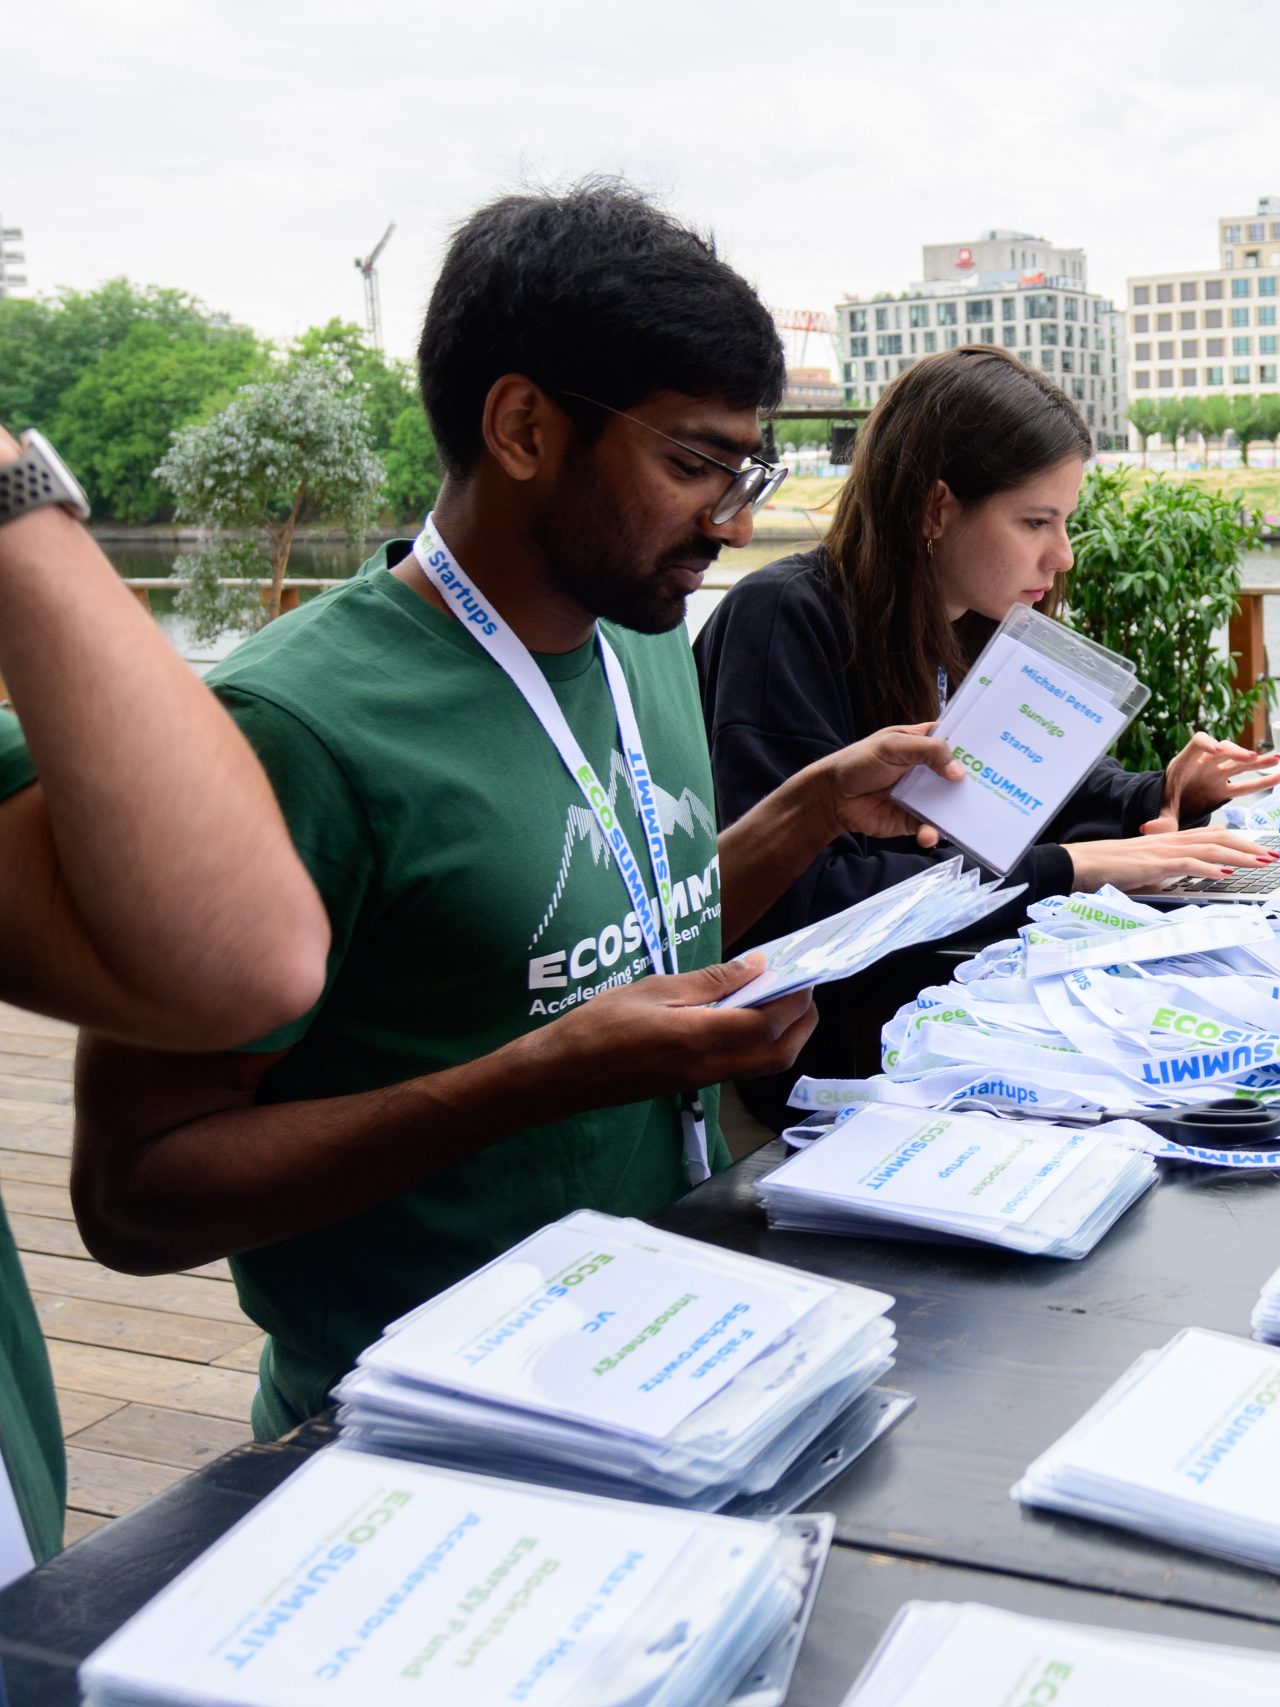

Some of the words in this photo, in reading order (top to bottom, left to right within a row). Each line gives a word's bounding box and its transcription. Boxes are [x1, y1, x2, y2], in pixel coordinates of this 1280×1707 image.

[428, 550, 498, 636] Startups
[1018, 703, 1066, 739] Sunvigo
[1020, 664, 1067, 700] Michael
[1065, 693, 1104, 725] Peters
[952, 746, 1044, 812] ECOSUMMIT
[999, 730, 1044, 765] Startup
[575, 764, 660, 952] ECOSUMMIT
[529, 965, 633, 1016] Accelerating
[865, 1120, 952, 1190] ECOSUMMIT
[937, 1144, 982, 1179] Startup
[463, 1253, 615, 1367] ECOSUMMIT
[582, 1310, 616, 1334] VC
[591, 1293, 699, 1377] InnoEnergy
[638, 1302, 751, 1393] Sacharowitz
[690, 1327, 755, 1378] Fabian
[224, 1489, 415, 1672] ECOSUMMIT
[355, 1511, 481, 1641] Accelerator
[458, 1535, 539, 1613] Energy
[596, 1550, 645, 1596] Max
[313, 1645, 363, 1680] VC
[401, 1618, 467, 1678] Fund
